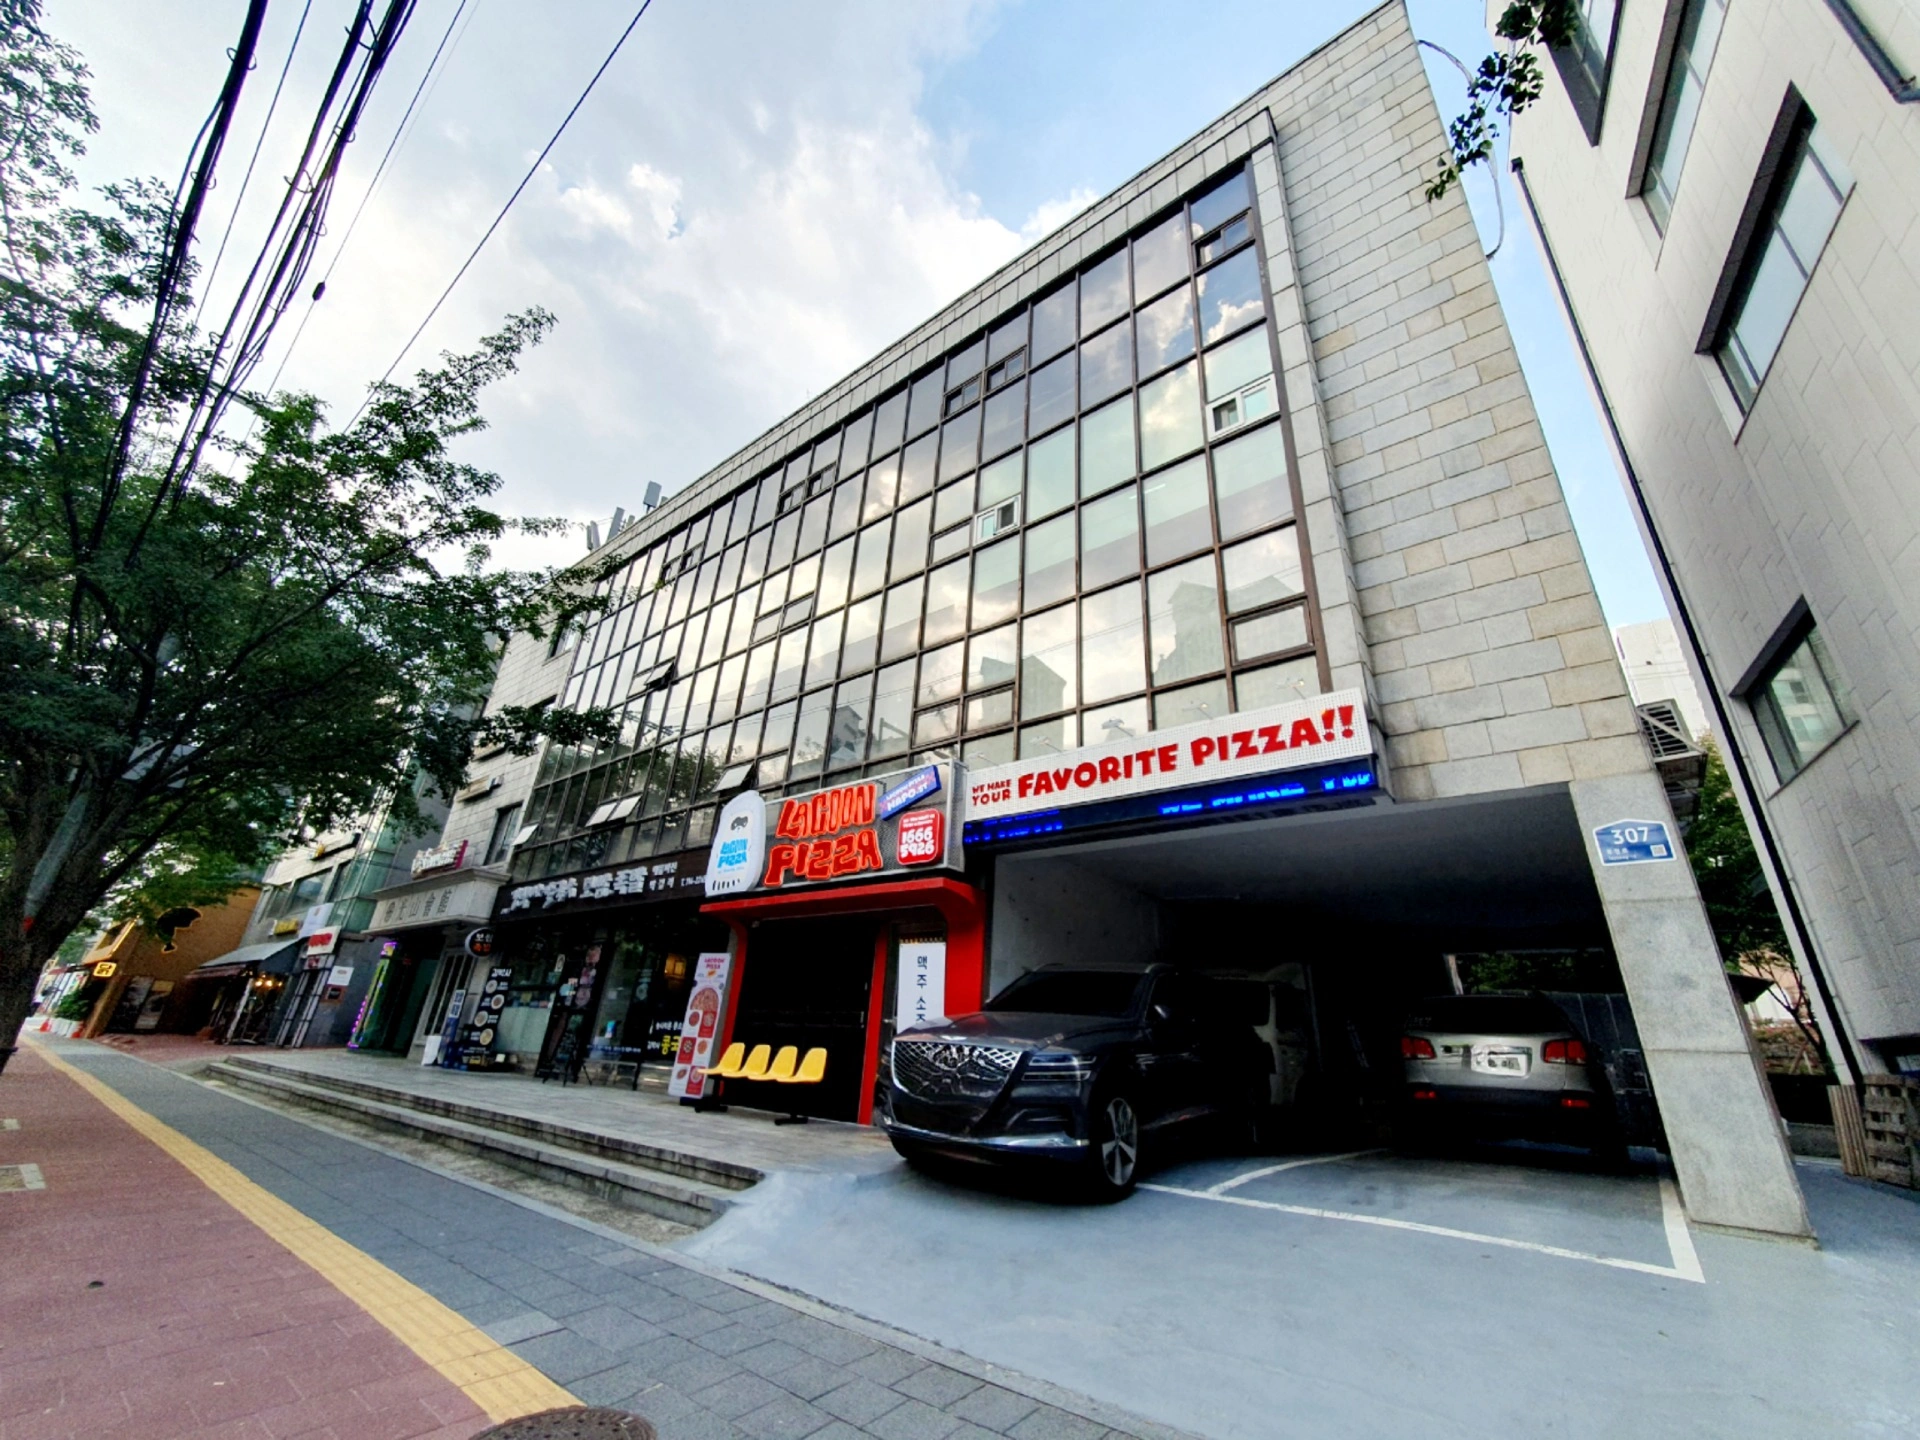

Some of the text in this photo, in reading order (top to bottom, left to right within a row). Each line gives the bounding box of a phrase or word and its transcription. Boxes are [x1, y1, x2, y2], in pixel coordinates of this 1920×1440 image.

[1017, 743, 1179, 798] FAVORITE
[1190, 704, 1355, 766] PIZZA!!
[971, 779, 1012, 795] WE MAKE
[971, 788, 1012, 806] YOUR
[775, 783, 877, 840] LAGOON
[902, 826, 934, 844] 1666
[1611, 827, 1648, 845] 307
[765, 828, 883, 887] PIZZA
[900, 840, 935, 858] 5926
[717, 851, 748, 869] PIZZA
